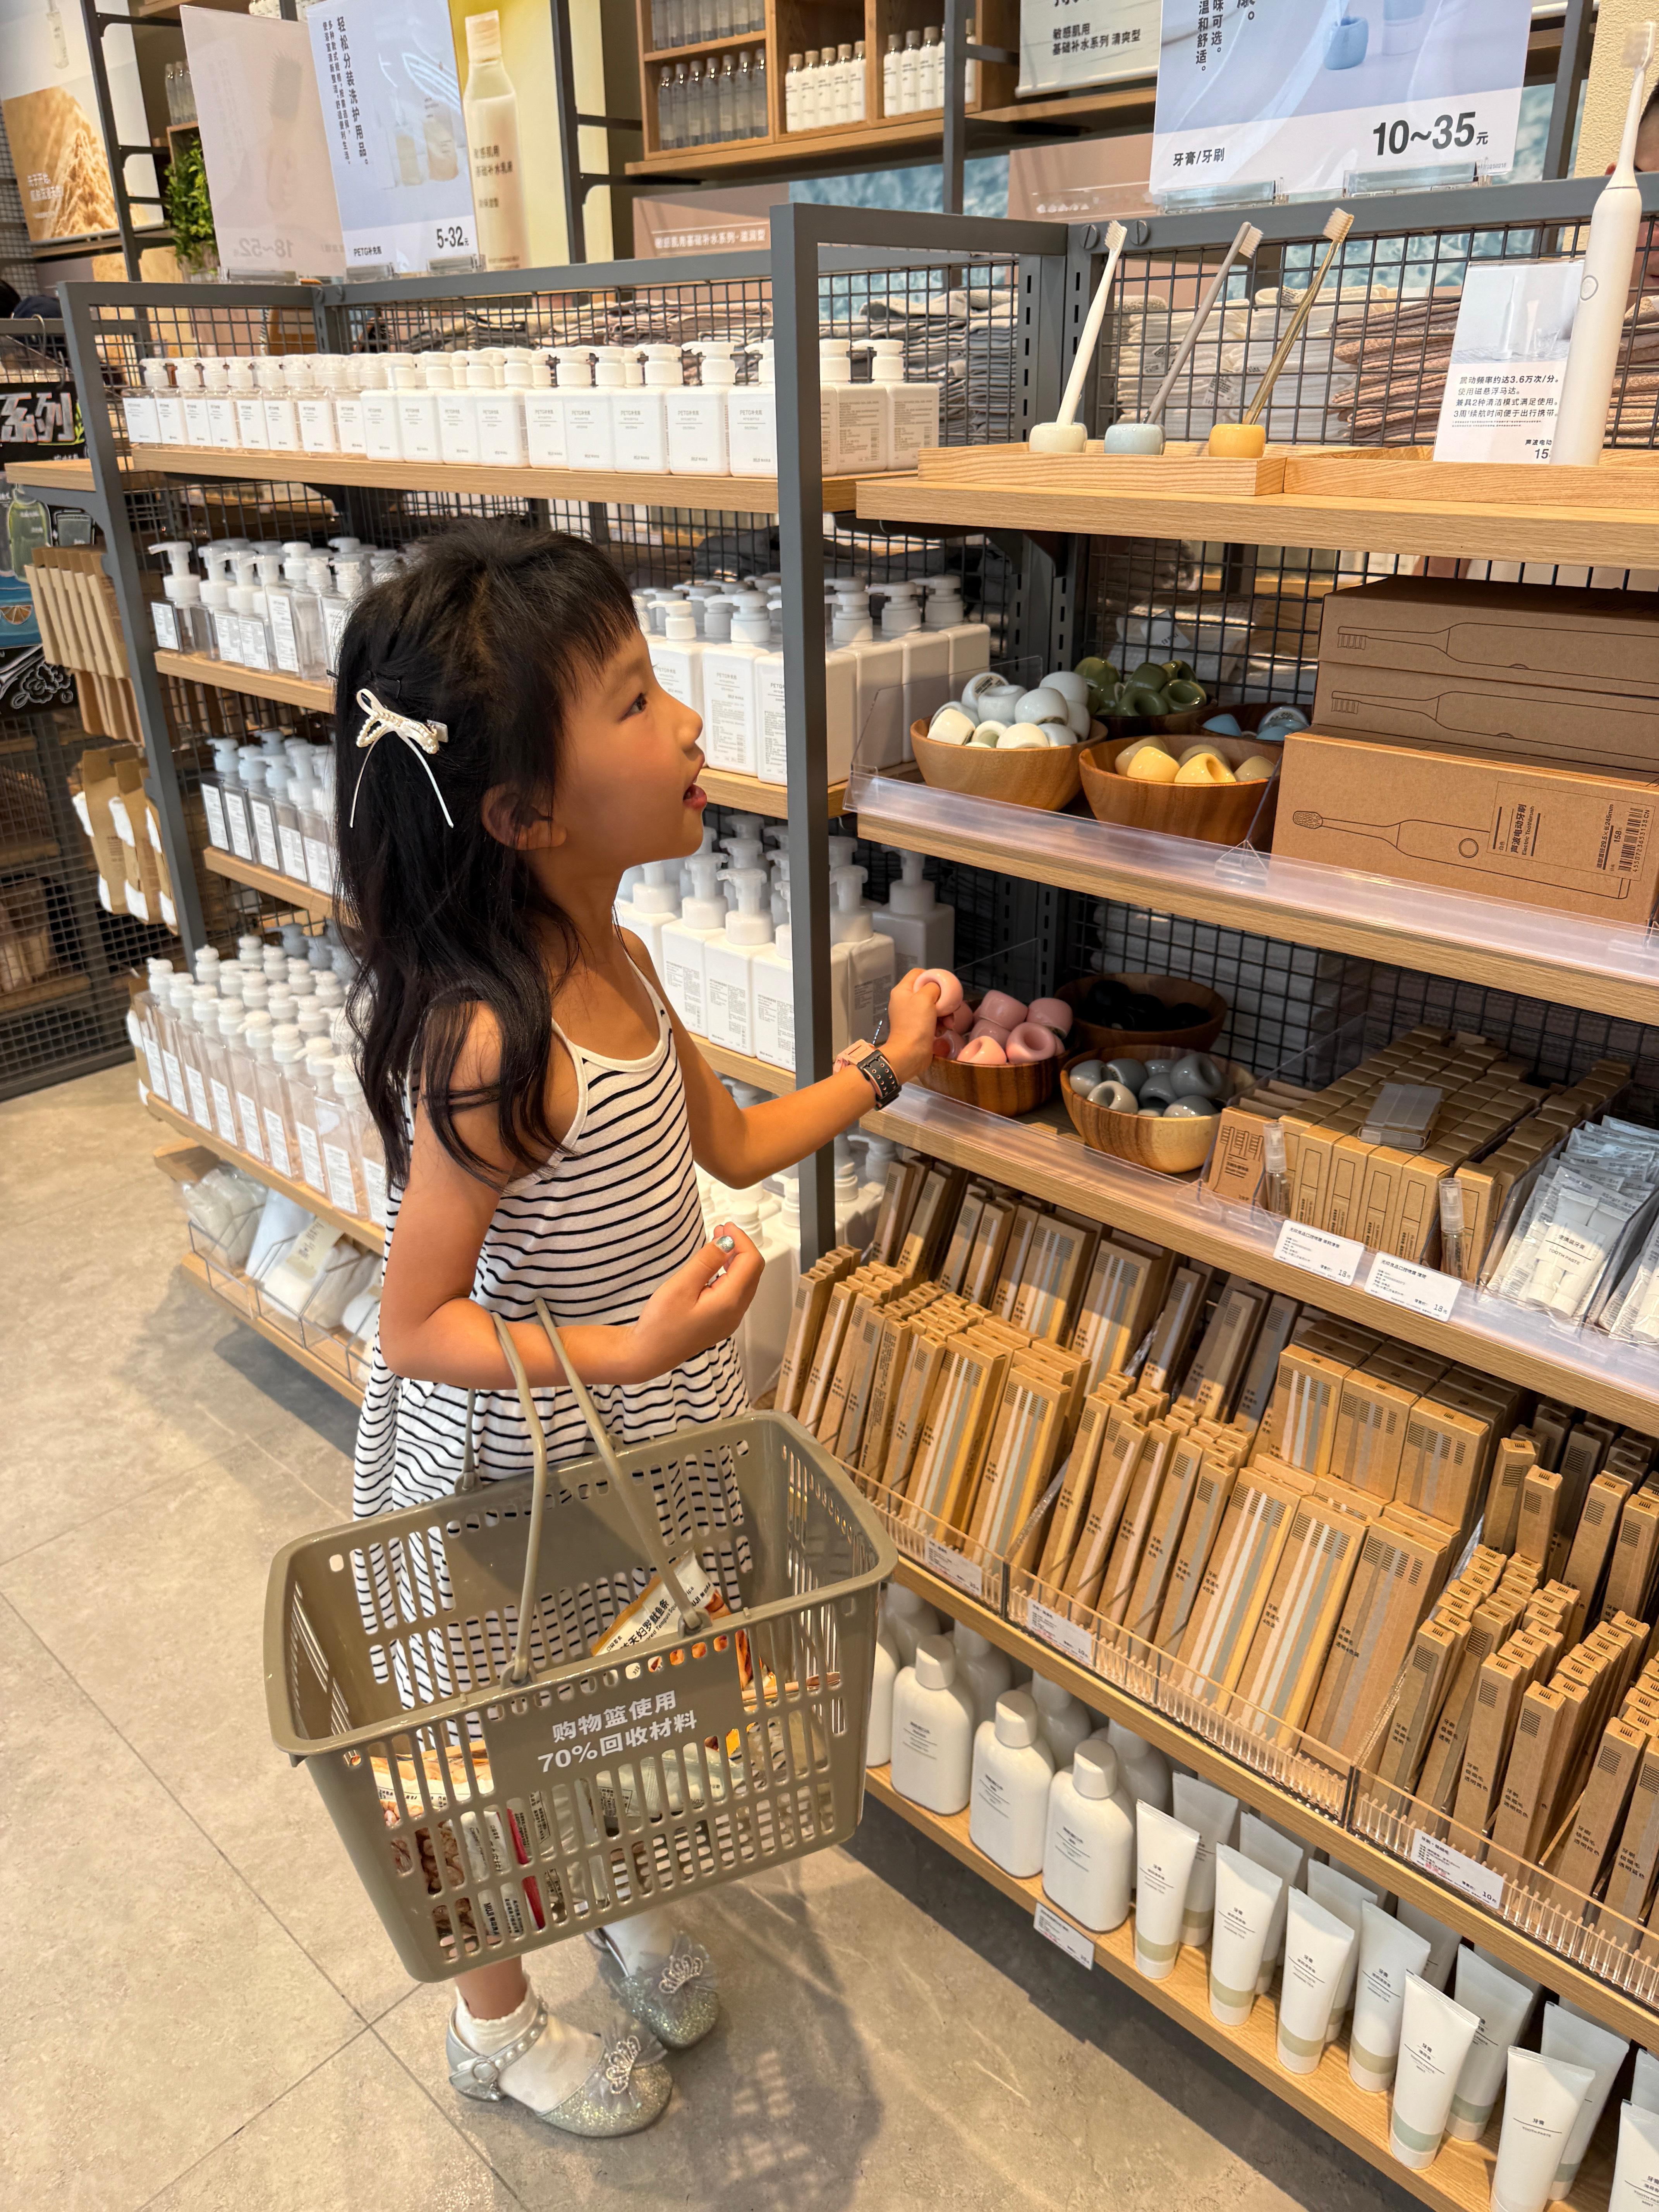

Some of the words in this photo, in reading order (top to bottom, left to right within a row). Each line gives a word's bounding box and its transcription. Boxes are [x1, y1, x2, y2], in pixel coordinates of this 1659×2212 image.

[1173, 148, 1225, 167] 牙膏/牙刷
[1458, 387, 1520, 395] 使用磁悬浮马达。
[1535, 448, 1551, 459] 15
[1511, 804, 1527, 853] 声波电动牙刷
[1525, 806, 1534, 835] Toothbrush
[1565, 1255, 1581, 1266] PASTE
[692, 1596, 701, 1607] UJI
[552, 1690, 676, 1743] 购物篮使用
[538, 1710, 697, 1772] 70%回收材料
